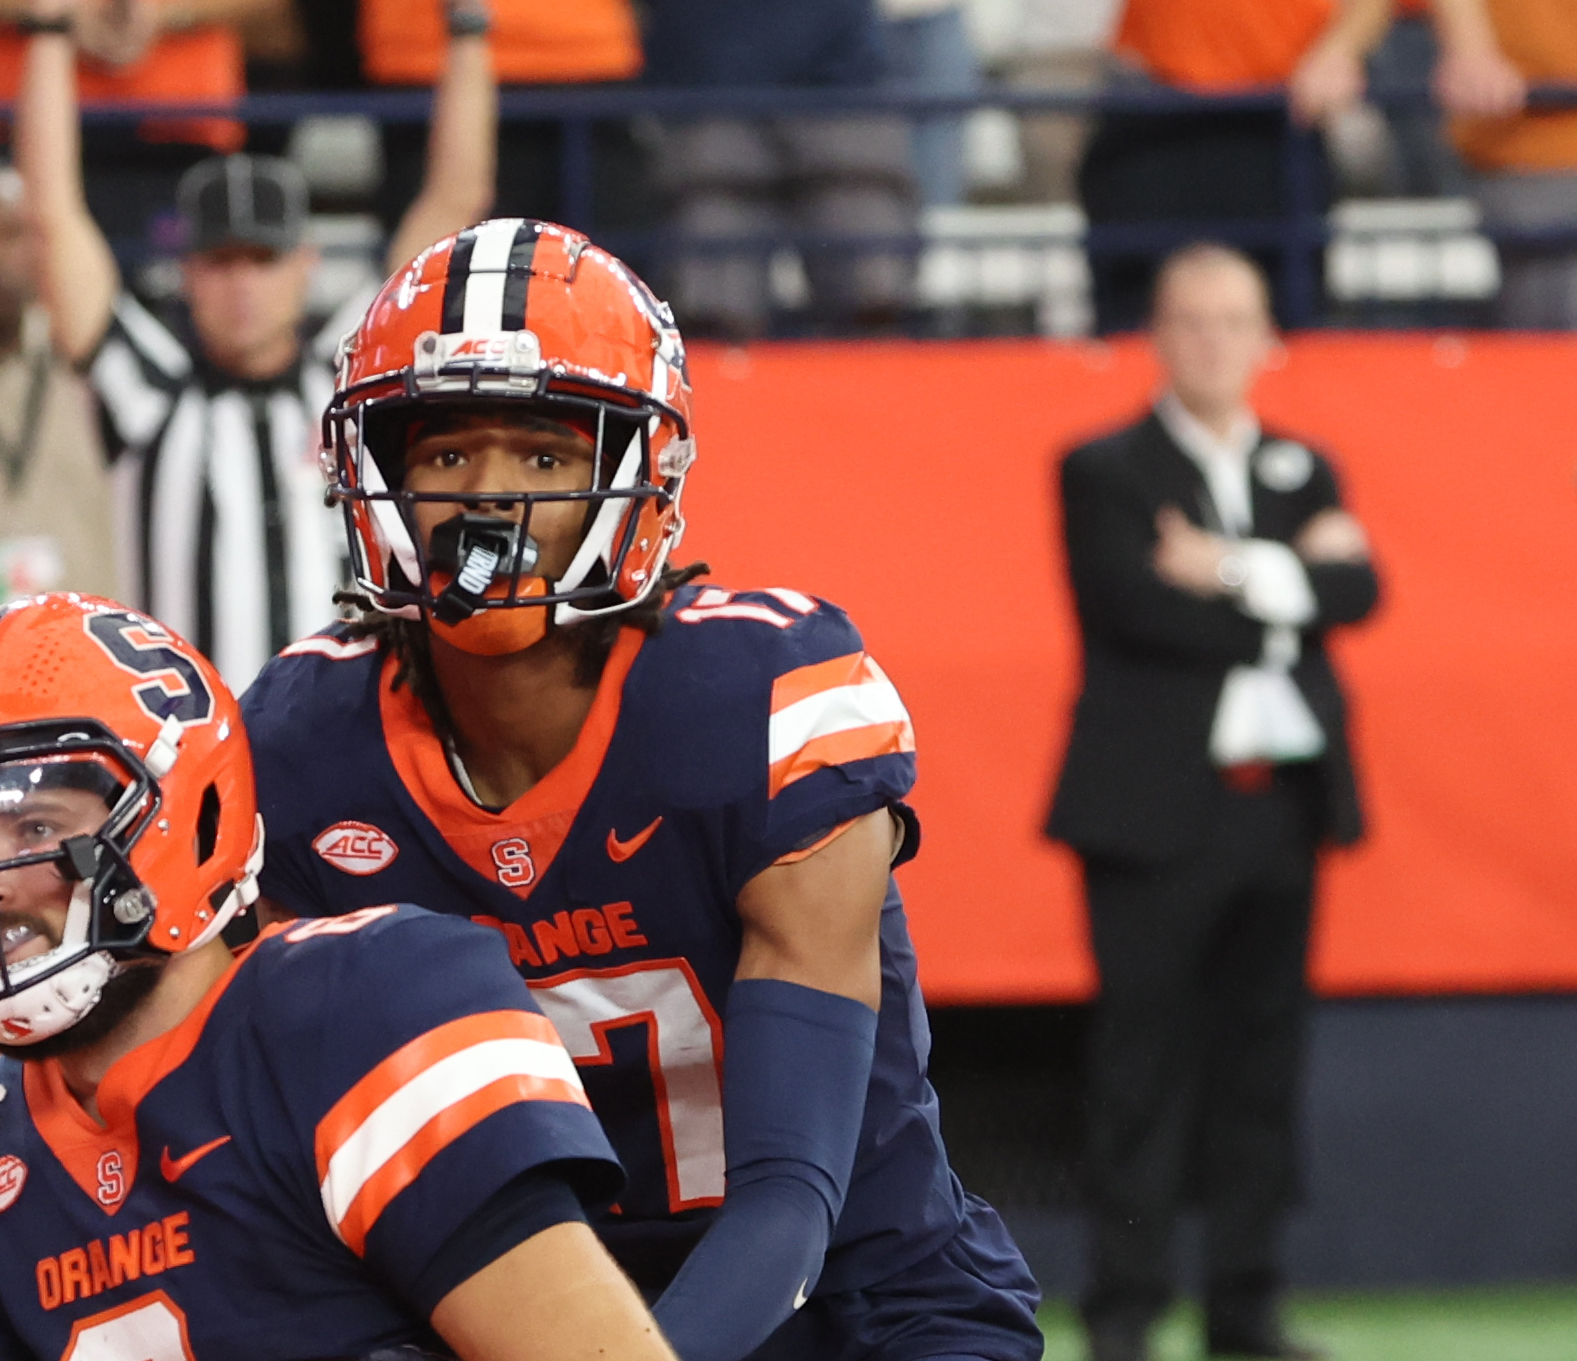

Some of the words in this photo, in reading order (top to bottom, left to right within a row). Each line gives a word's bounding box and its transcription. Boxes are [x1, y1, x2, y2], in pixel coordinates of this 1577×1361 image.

[451, 339, 509, 357] ACC
[83, 610, 216, 728] S
[325, 835, 383, 854] ACC
[491, 838, 534, 887] S
[470, 901, 648, 967] ANGE
[524, 957, 727, 1212] 7
[97, 1151, 124, 1205] S
[35, 1210, 196, 1311] ORANGE
